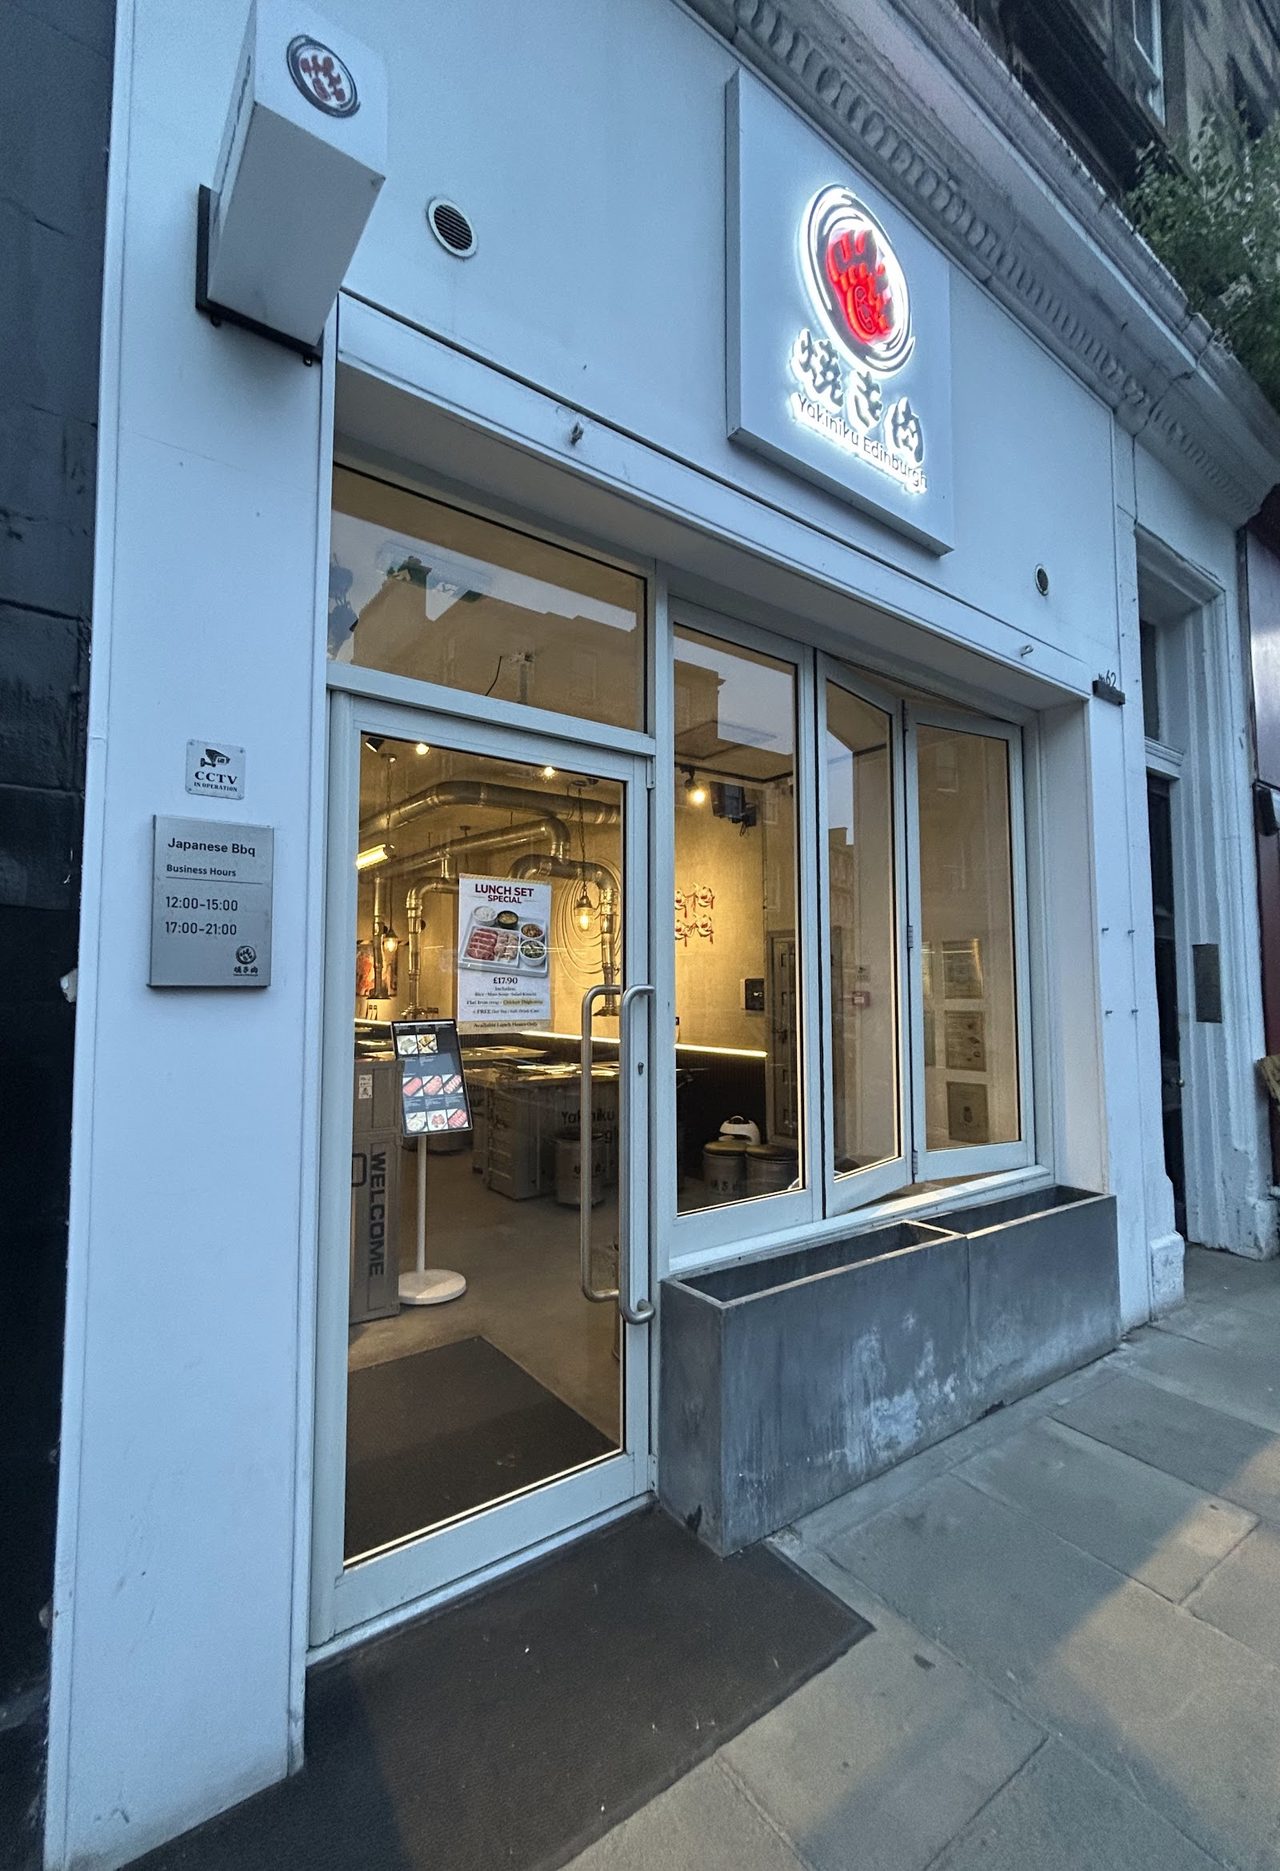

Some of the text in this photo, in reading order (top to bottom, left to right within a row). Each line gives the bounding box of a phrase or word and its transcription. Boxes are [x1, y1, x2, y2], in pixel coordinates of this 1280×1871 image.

[798, 394, 927, 489] Yakiniku Edinburgh
[195, 771, 238, 785] CCTV
[202, 783, 238, 792] OPERATION
[168, 838, 256, 857] Japanese Bbq
[166, 864, 237, 877] Business Hours
[475, 883, 534, 897] LUNCH SET
[488, 894, 522, 904] SPECIAL
[370, 1152, 386, 1277] WELCOME
